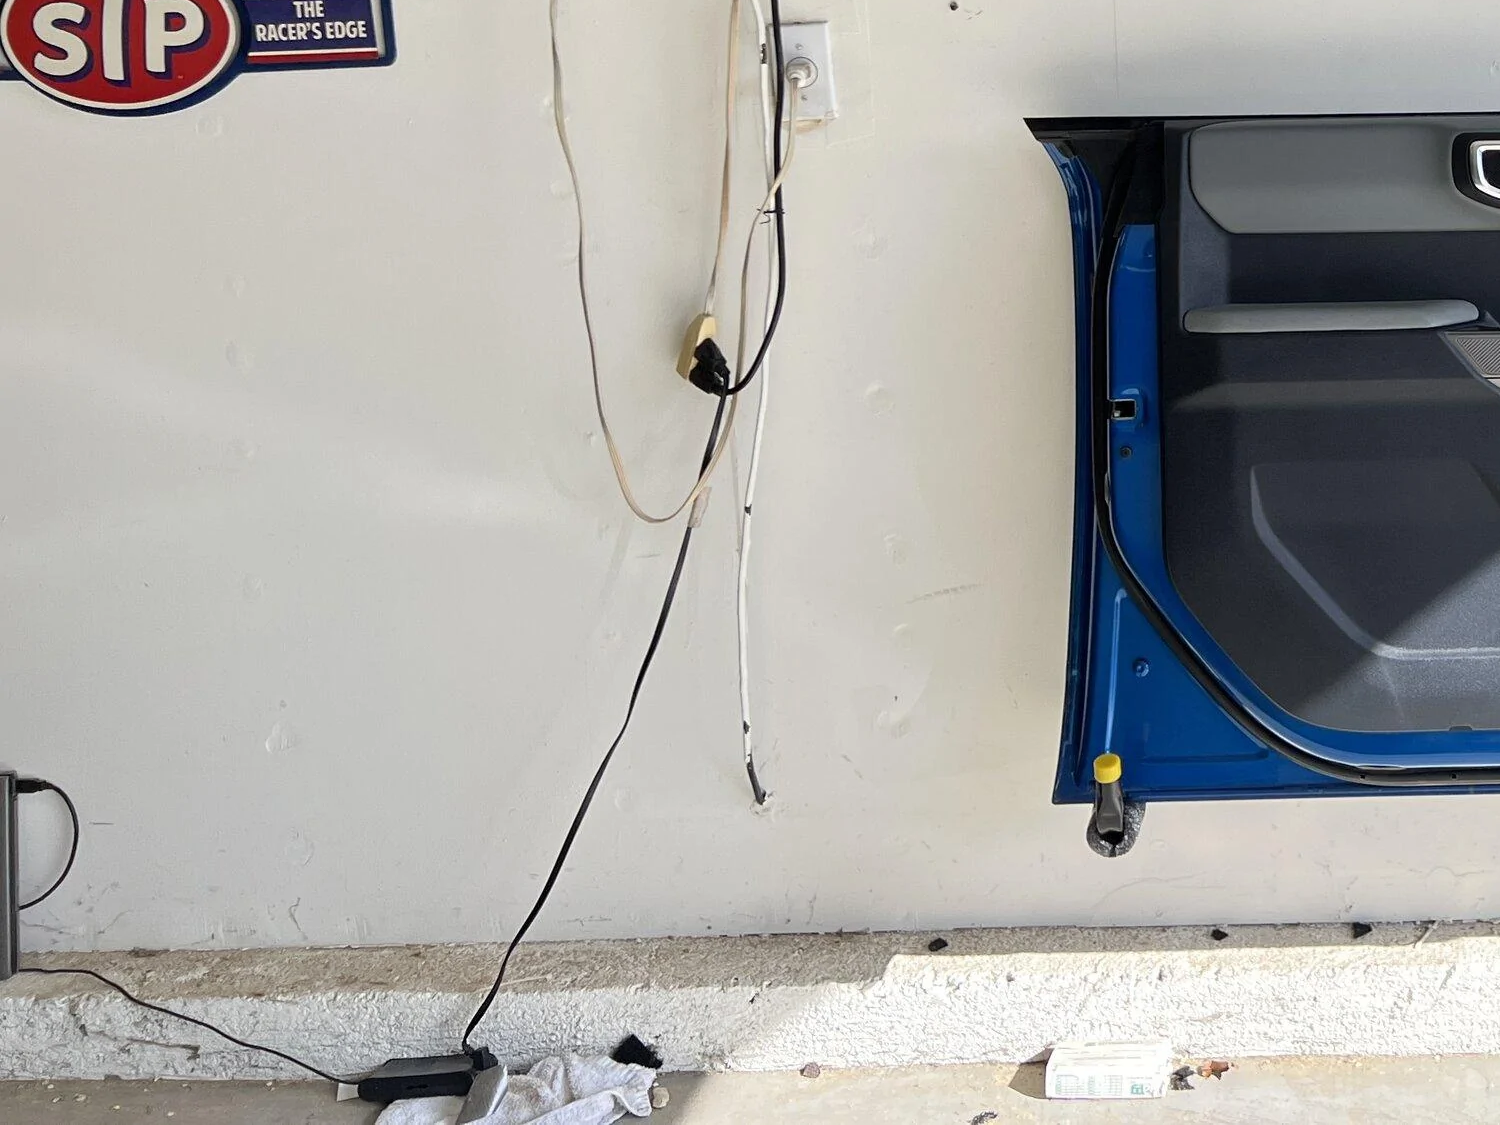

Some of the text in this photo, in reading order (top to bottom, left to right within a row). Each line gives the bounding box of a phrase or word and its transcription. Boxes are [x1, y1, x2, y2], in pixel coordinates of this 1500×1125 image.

[292, 0, 325, 19] THE
[255, 20, 367, 42] RACER'S EDGE
